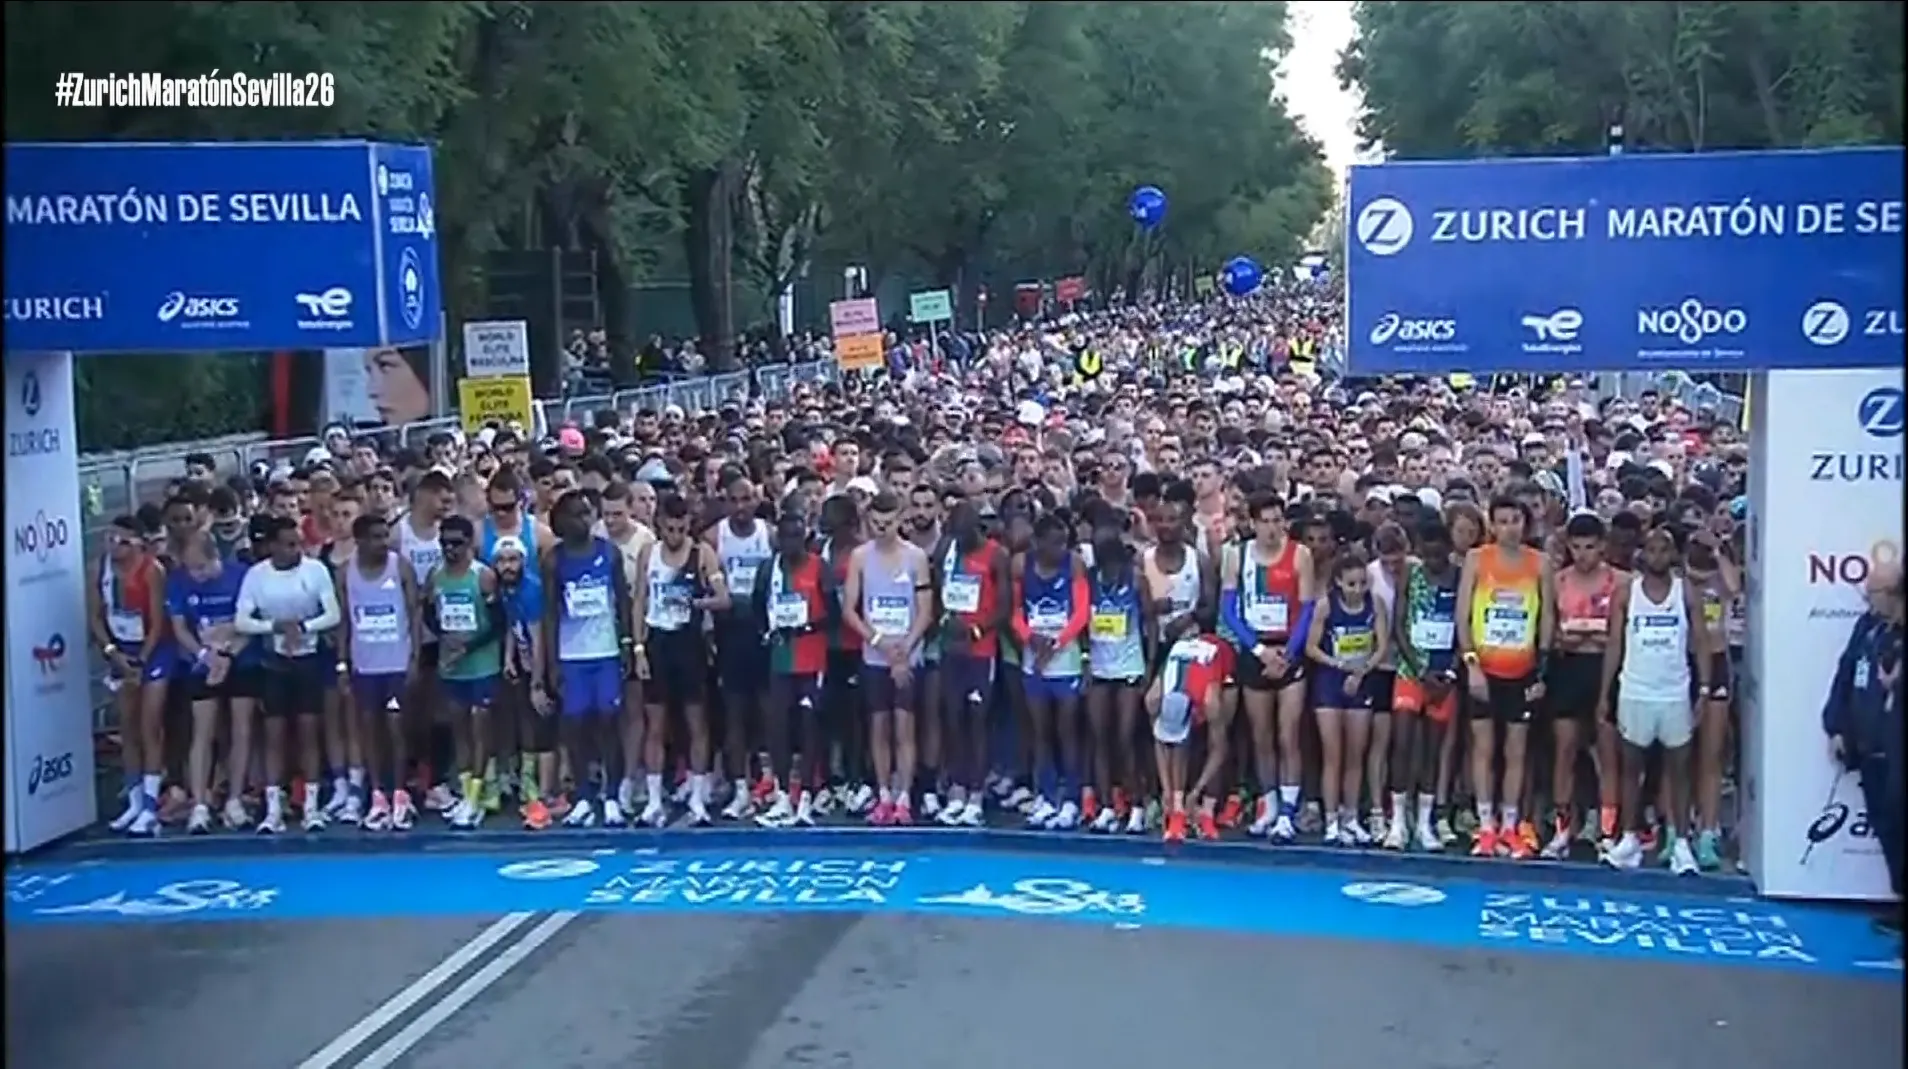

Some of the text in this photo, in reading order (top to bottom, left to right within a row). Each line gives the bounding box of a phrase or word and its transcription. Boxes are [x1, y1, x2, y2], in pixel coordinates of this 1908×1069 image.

[7, 187, 168, 224] MARATÓN
[179, 194, 221, 222] DE
[229, 193, 362, 222] SEVILLA
[1431, 208, 1585, 241] ZURICH
[1608, 197, 1784, 239] MARATÓN
[1797, 203, 1845, 233] DE
[1855, 201, 1903, 233] SE
[1398, 319, 1457, 341] asics
[584, 889, 887, 903] SEVILLA
